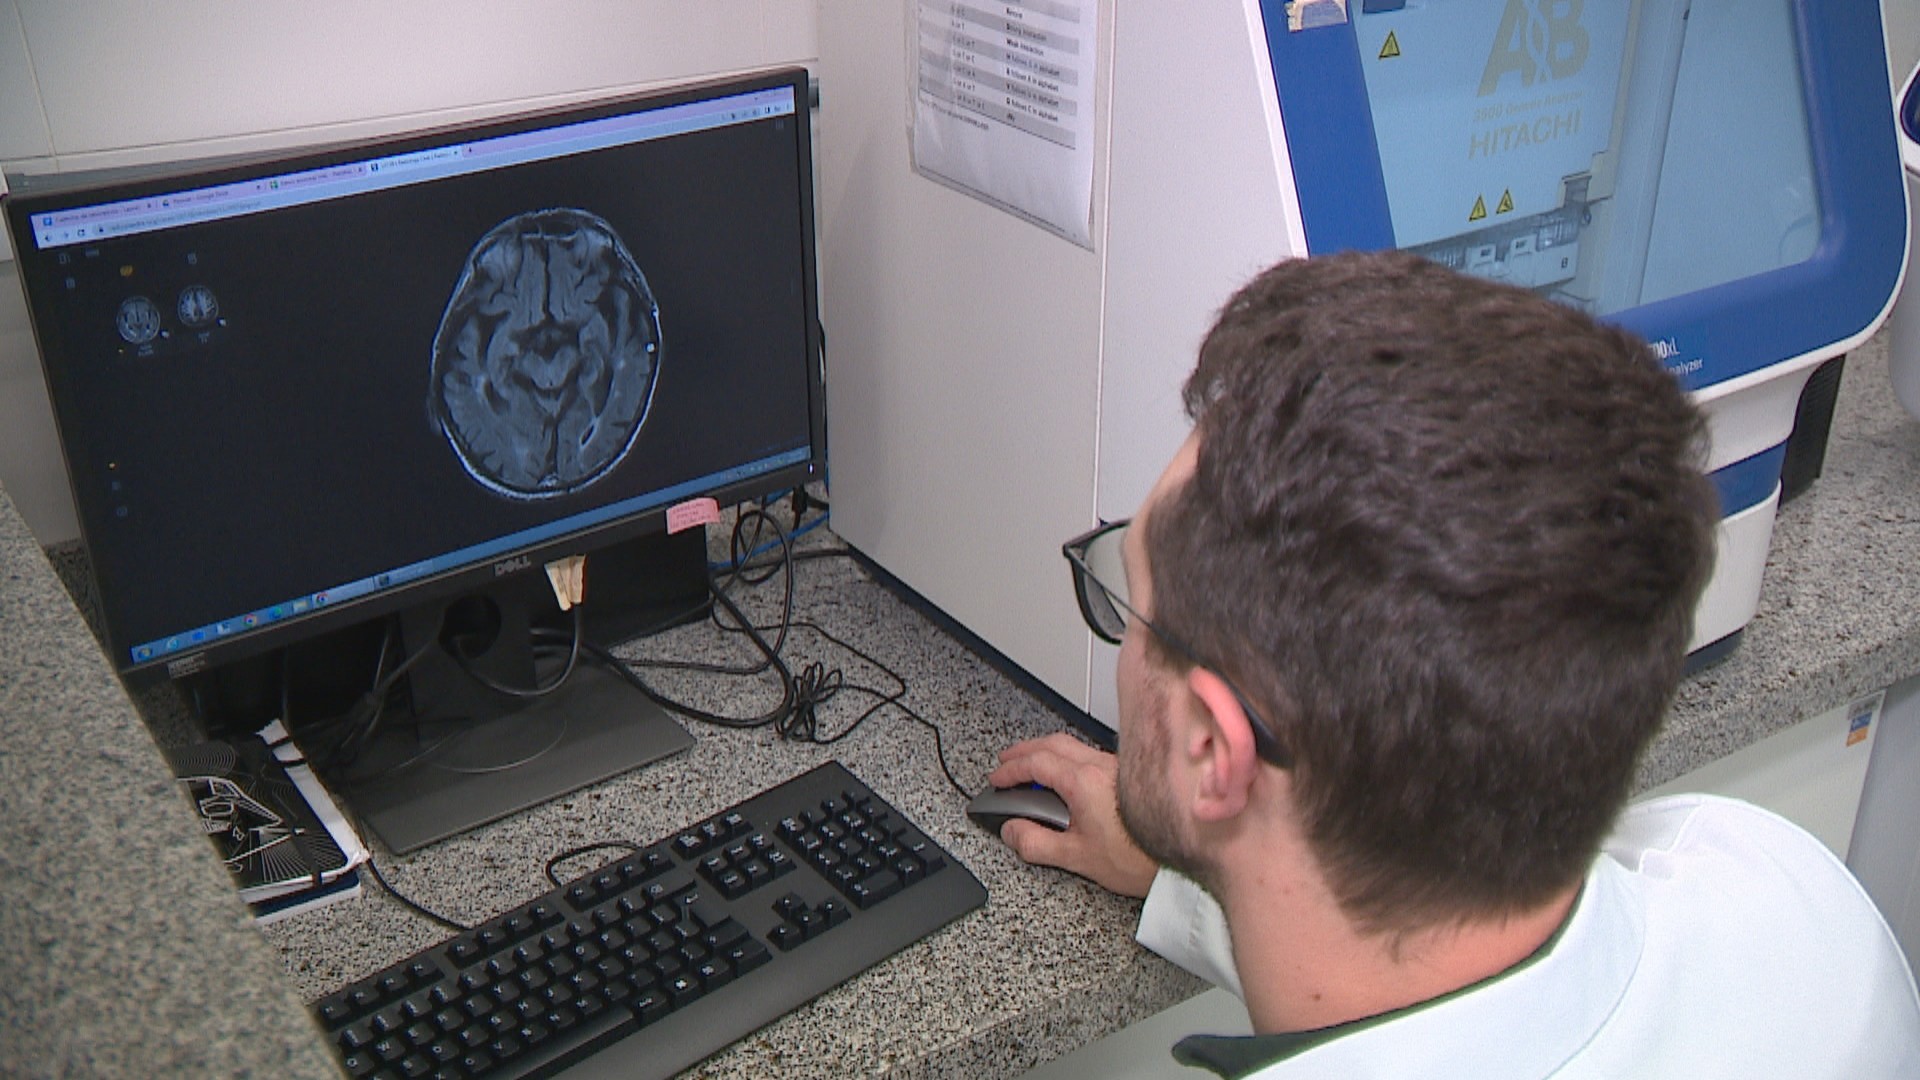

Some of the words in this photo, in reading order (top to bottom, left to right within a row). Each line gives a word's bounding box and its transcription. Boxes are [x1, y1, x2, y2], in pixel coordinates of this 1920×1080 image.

[1468, 107, 1583, 160] HITACHI
[1648, 337, 1681, 360] 00xL
[1667, 359, 1704, 376] nalyzer
[494, 555, 532, 577] DELL
